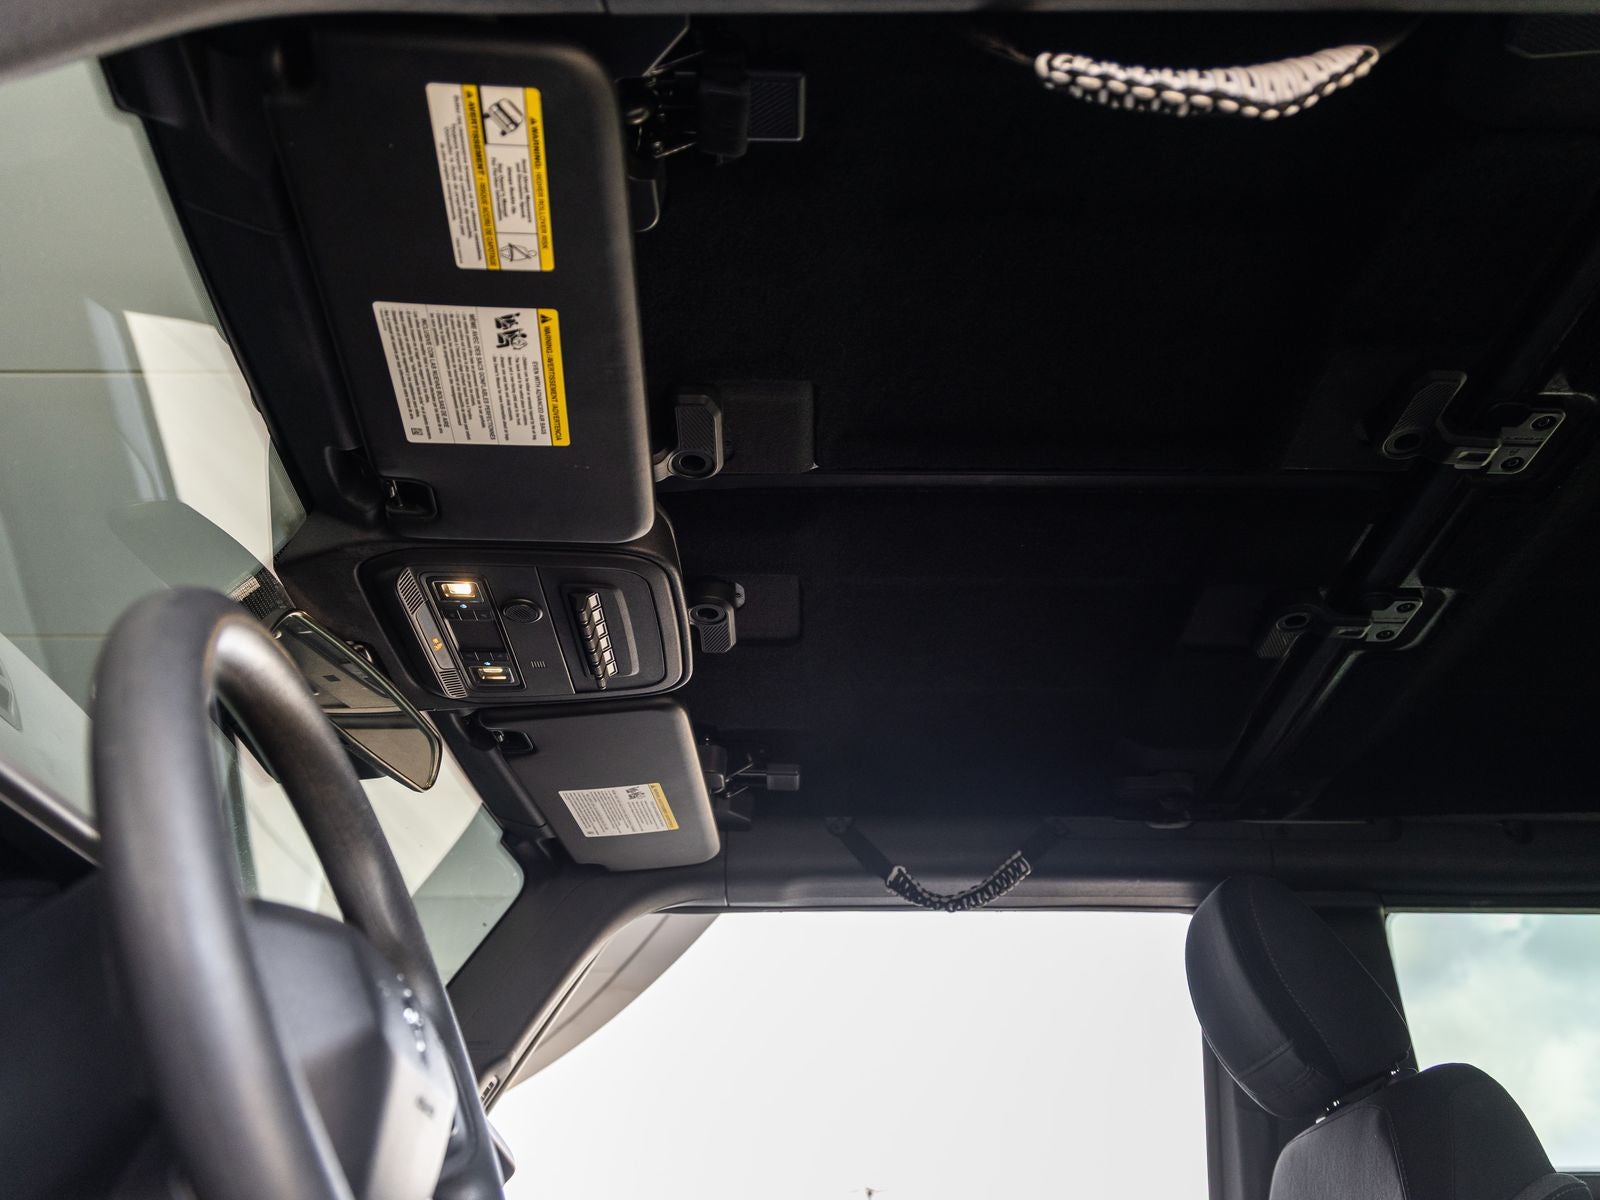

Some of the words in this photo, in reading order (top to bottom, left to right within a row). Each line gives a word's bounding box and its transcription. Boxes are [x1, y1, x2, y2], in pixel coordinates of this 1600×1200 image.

[466, 101, 484, 175] AVERTISSEMENT
[538, 198, 546, 233] ROLLOVER
[470, 329, 479, 343] AVEC
[542, 325, 552, 353] WARNING
[426, 346, 434, 357] CON
[531, 361, 539, 374] EVEN
[533, 375, 541, 387] WITH
[535, 388, 544, 413] ADVANCED
